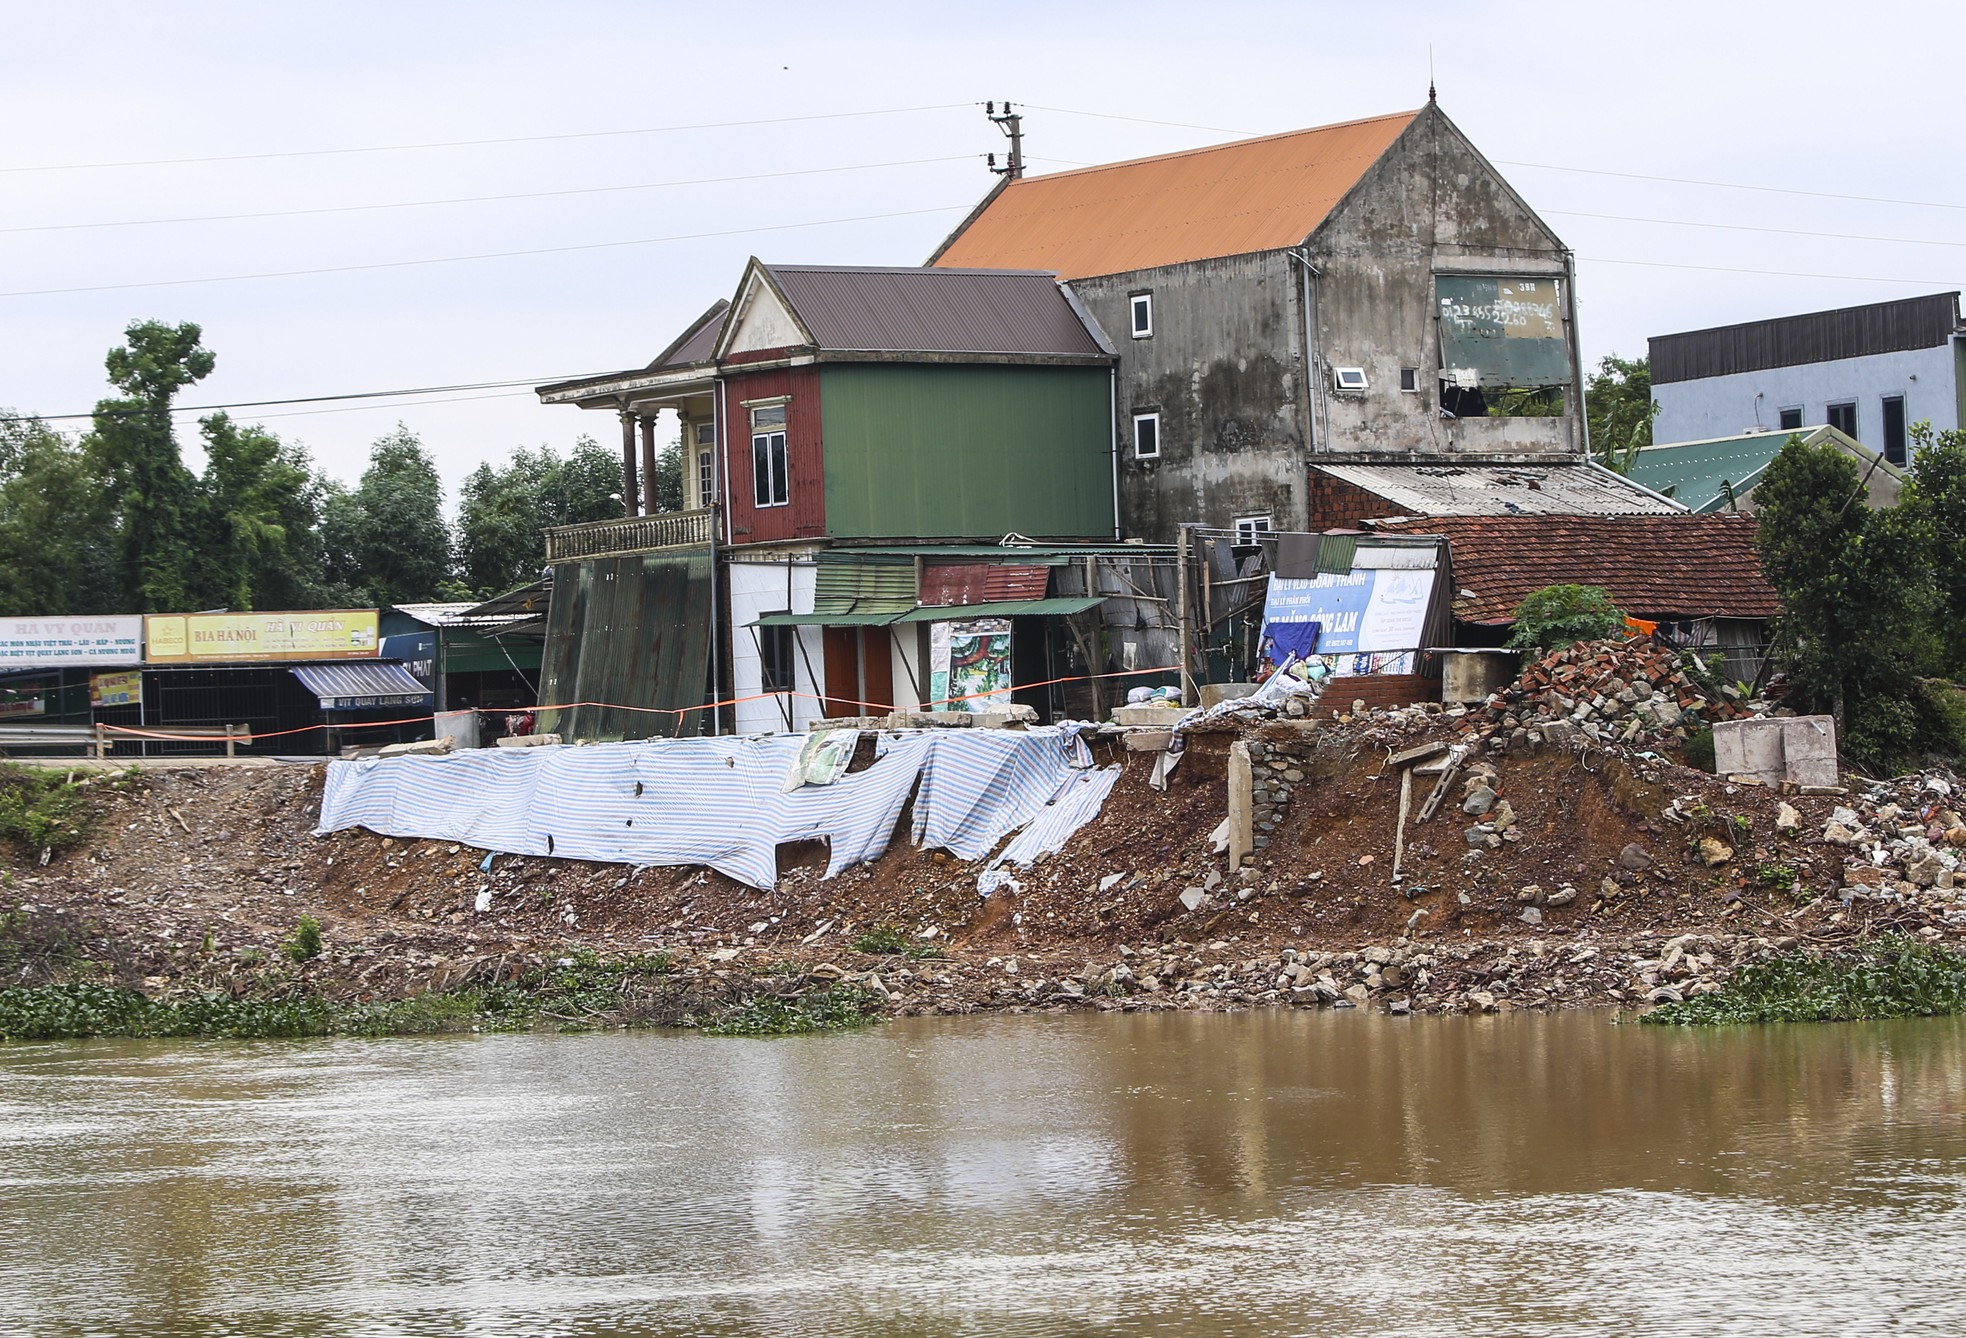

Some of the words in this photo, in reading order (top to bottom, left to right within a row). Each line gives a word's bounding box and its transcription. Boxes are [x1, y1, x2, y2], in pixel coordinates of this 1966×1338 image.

[1334, 611, 1359, 633] LAM
[194, 630, 216, 642] BIA
[217, 626, 235, 641] HÀ
[235, 626, 257, 642] NỘI
[355, 697, 377, 706] QUAY
